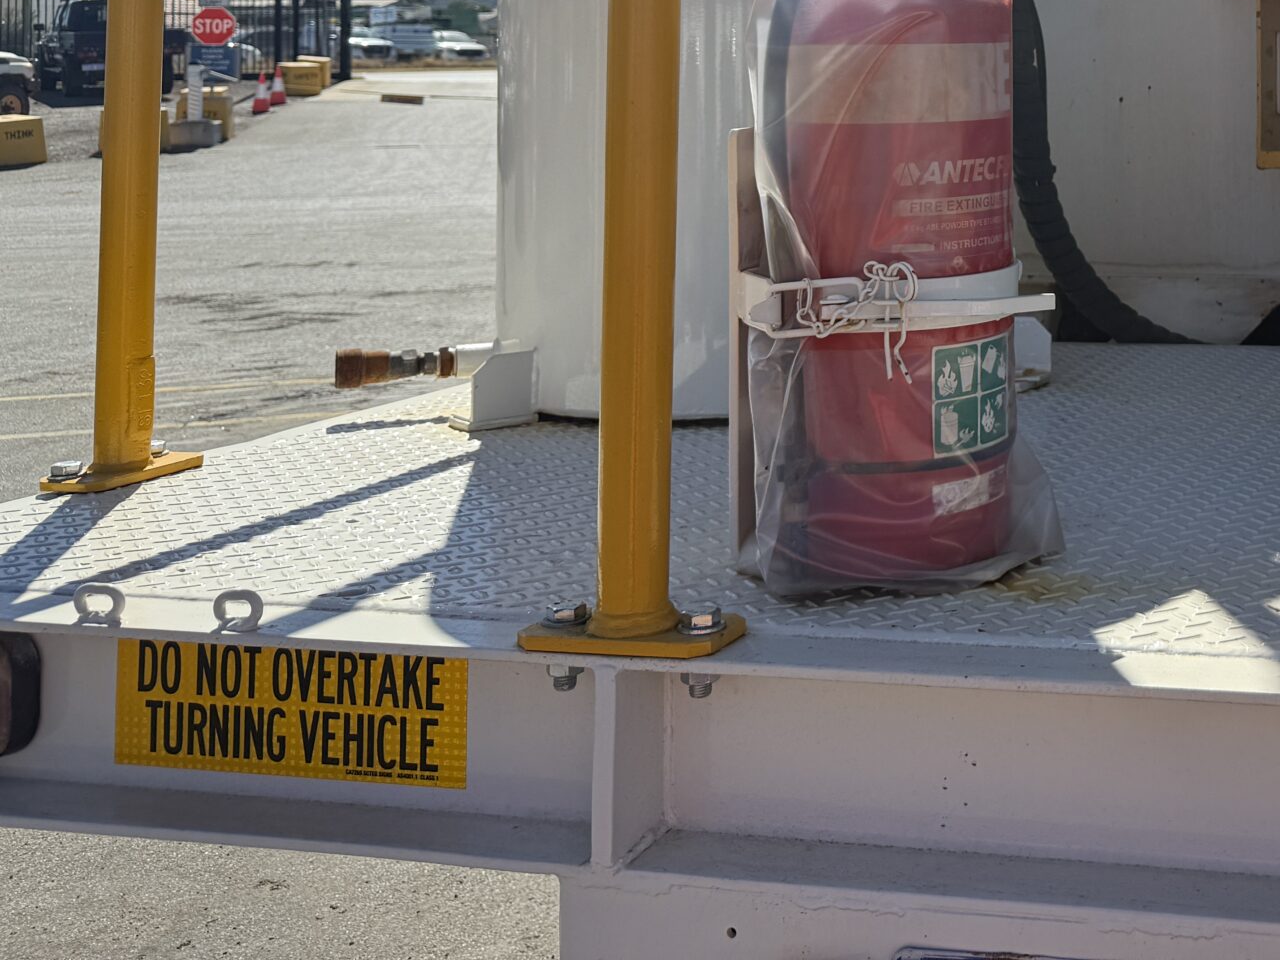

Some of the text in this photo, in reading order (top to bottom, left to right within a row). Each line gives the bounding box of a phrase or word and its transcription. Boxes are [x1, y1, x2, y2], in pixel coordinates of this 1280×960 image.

[194, 18, 233, 34] STOP
[5, 129, 34, 140] THINK
[910, 201, 944, 213] FIRE
[138, 640, 444, 711] DO NOT OVERTAKE
[145, 700, 438, 772] TURNING VEHICLE
